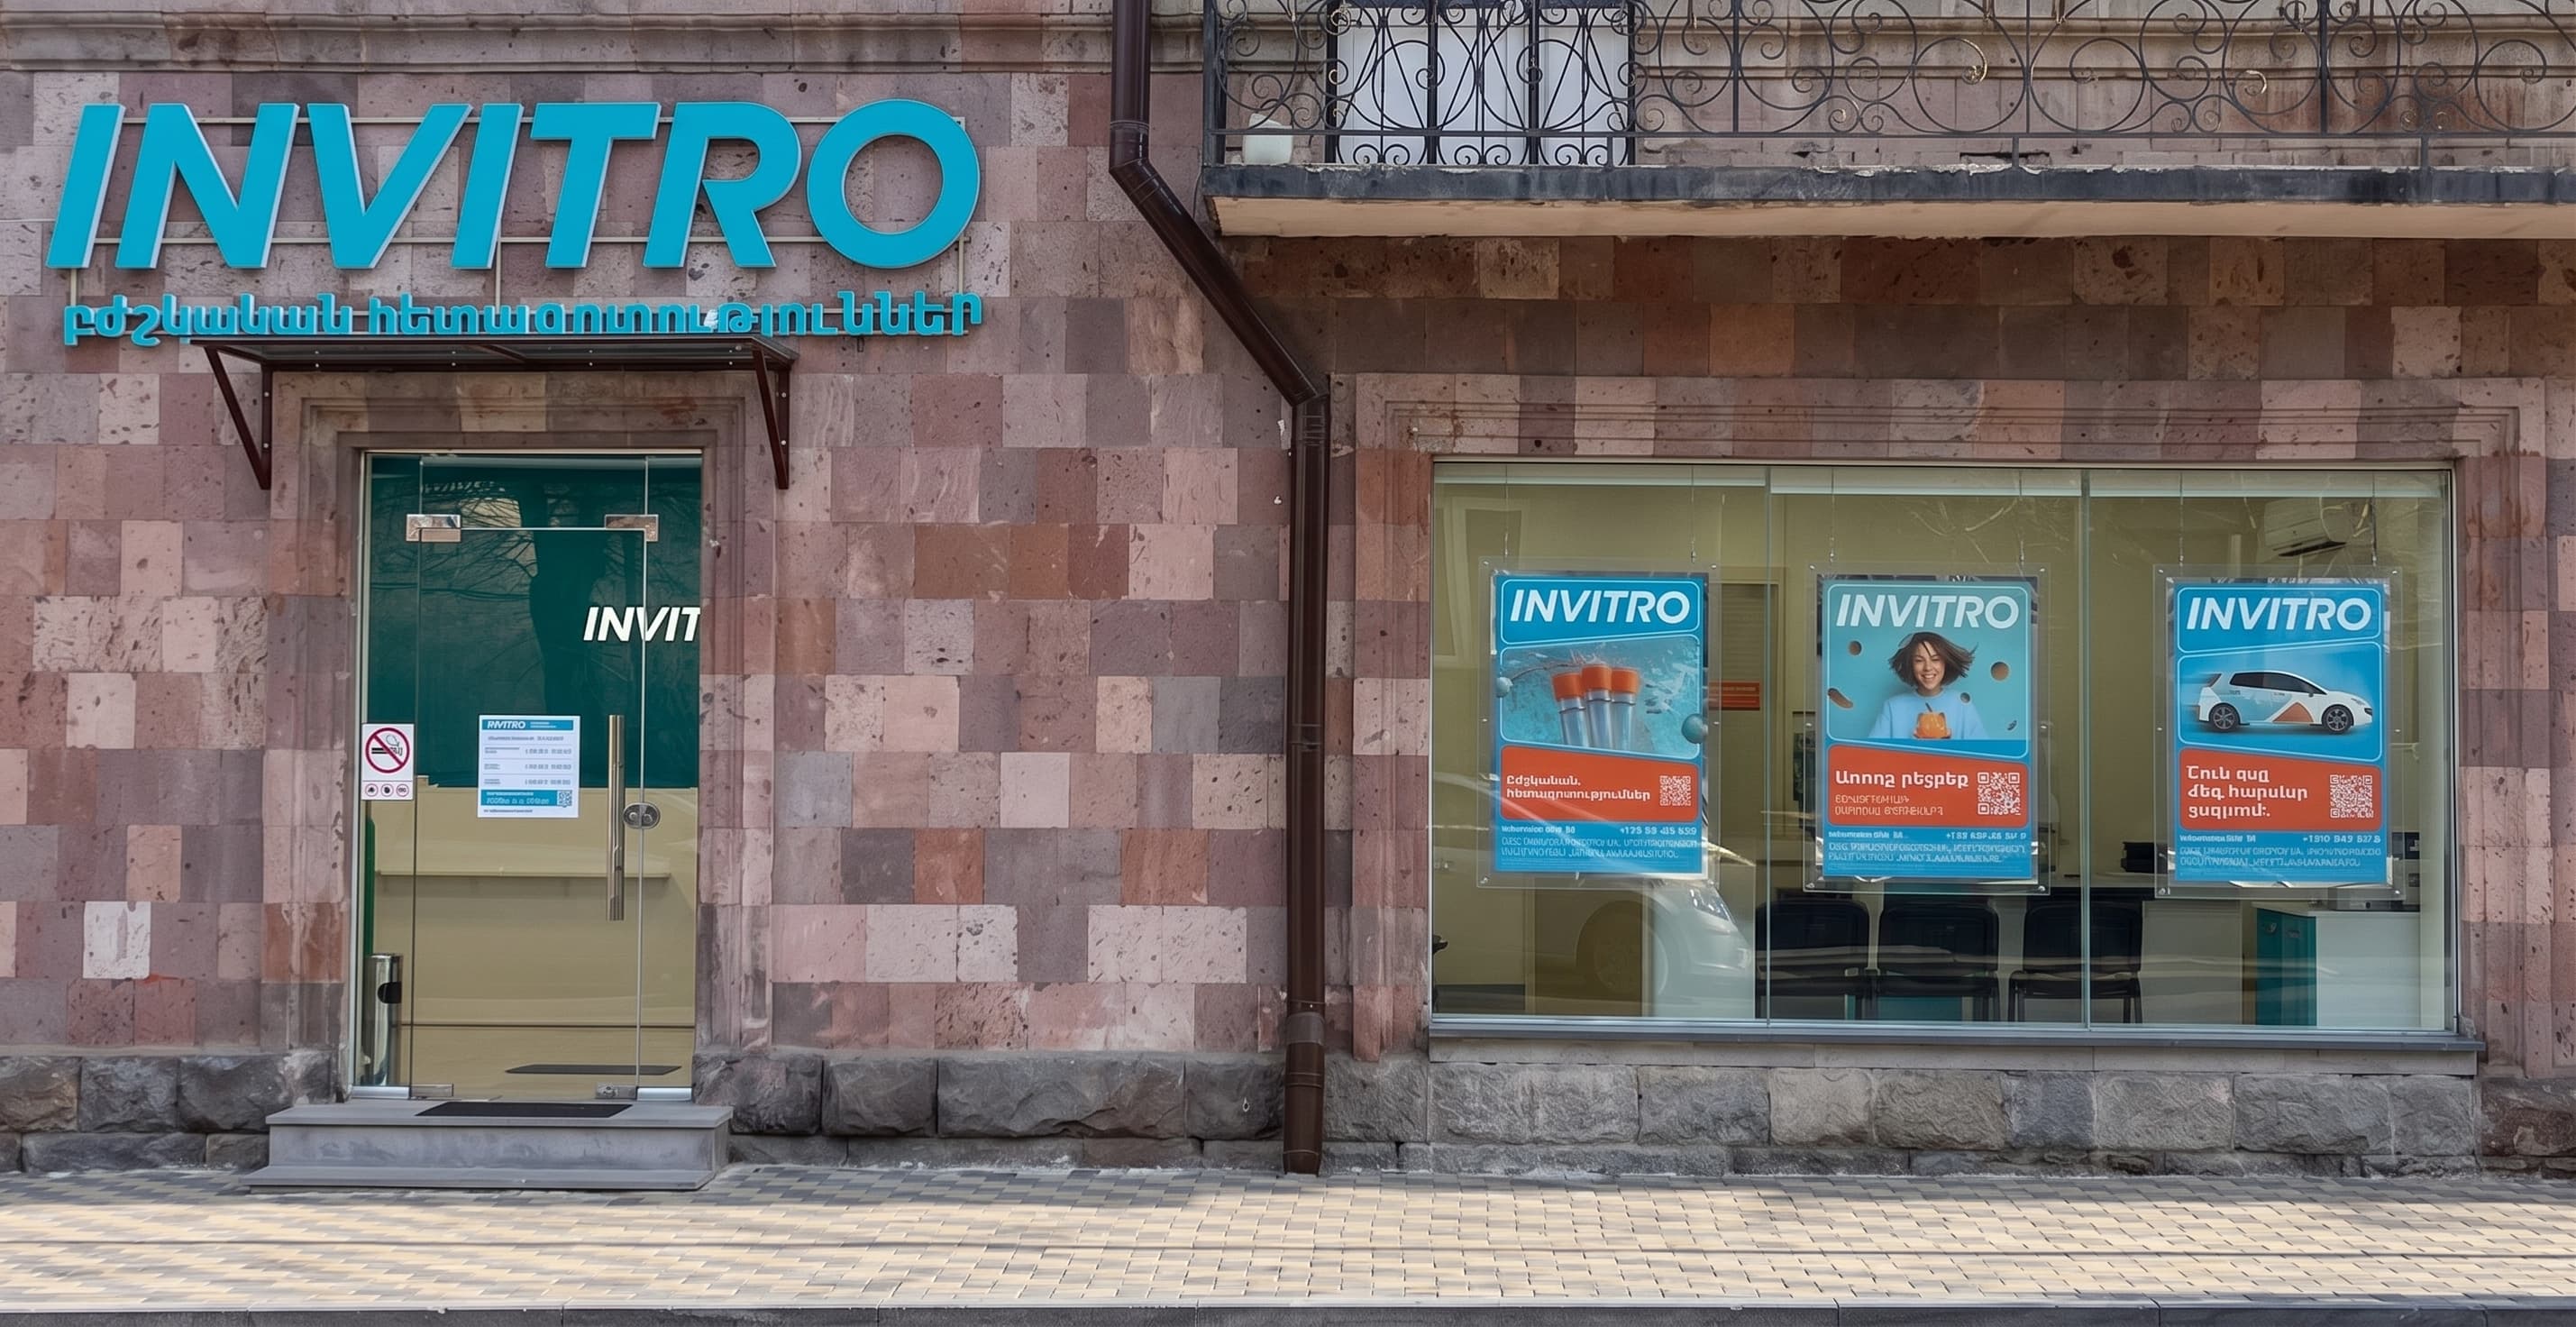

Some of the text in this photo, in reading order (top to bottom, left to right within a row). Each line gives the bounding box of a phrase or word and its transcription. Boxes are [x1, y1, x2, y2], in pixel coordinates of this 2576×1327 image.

[46, 98, 981, 269] INVITRO
[1510, 589, 1690, 624] INVITRO
[1836, 594, 2019, 629] INVITRO
[2187, 597, 2371, 631] INVITRO
